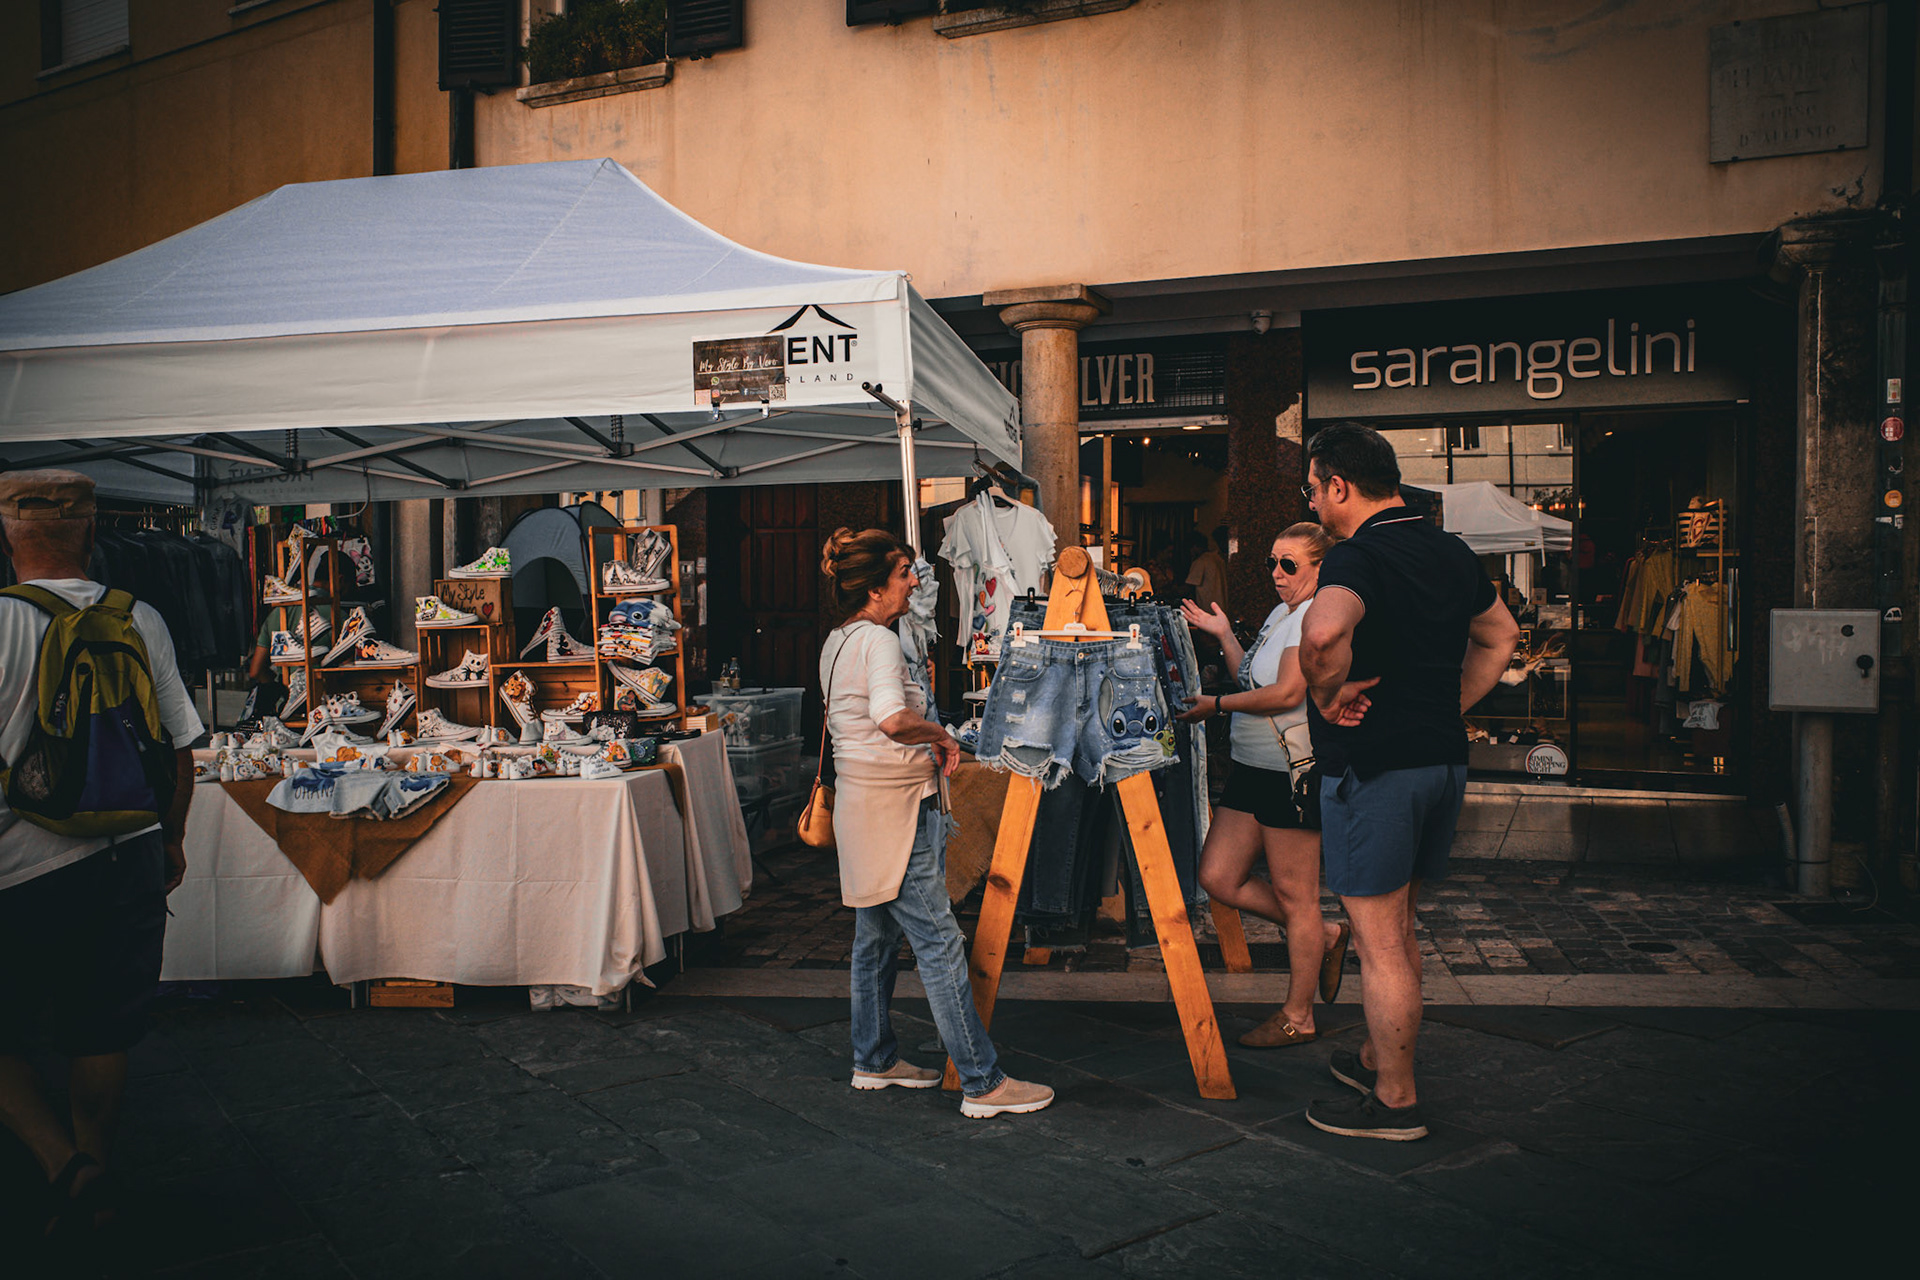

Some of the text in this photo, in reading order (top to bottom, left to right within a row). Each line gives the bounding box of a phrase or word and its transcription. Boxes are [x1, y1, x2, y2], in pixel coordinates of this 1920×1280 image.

[699, 359, 714, 373] My
[717, 356, 740, 372] Style
[787, 334, 858, 365] ENT
[1350, 317, 1697, 400] sarangelini
[1080, 352, 1156, 406] LVER
[441, 583, 485, 606] My Style
